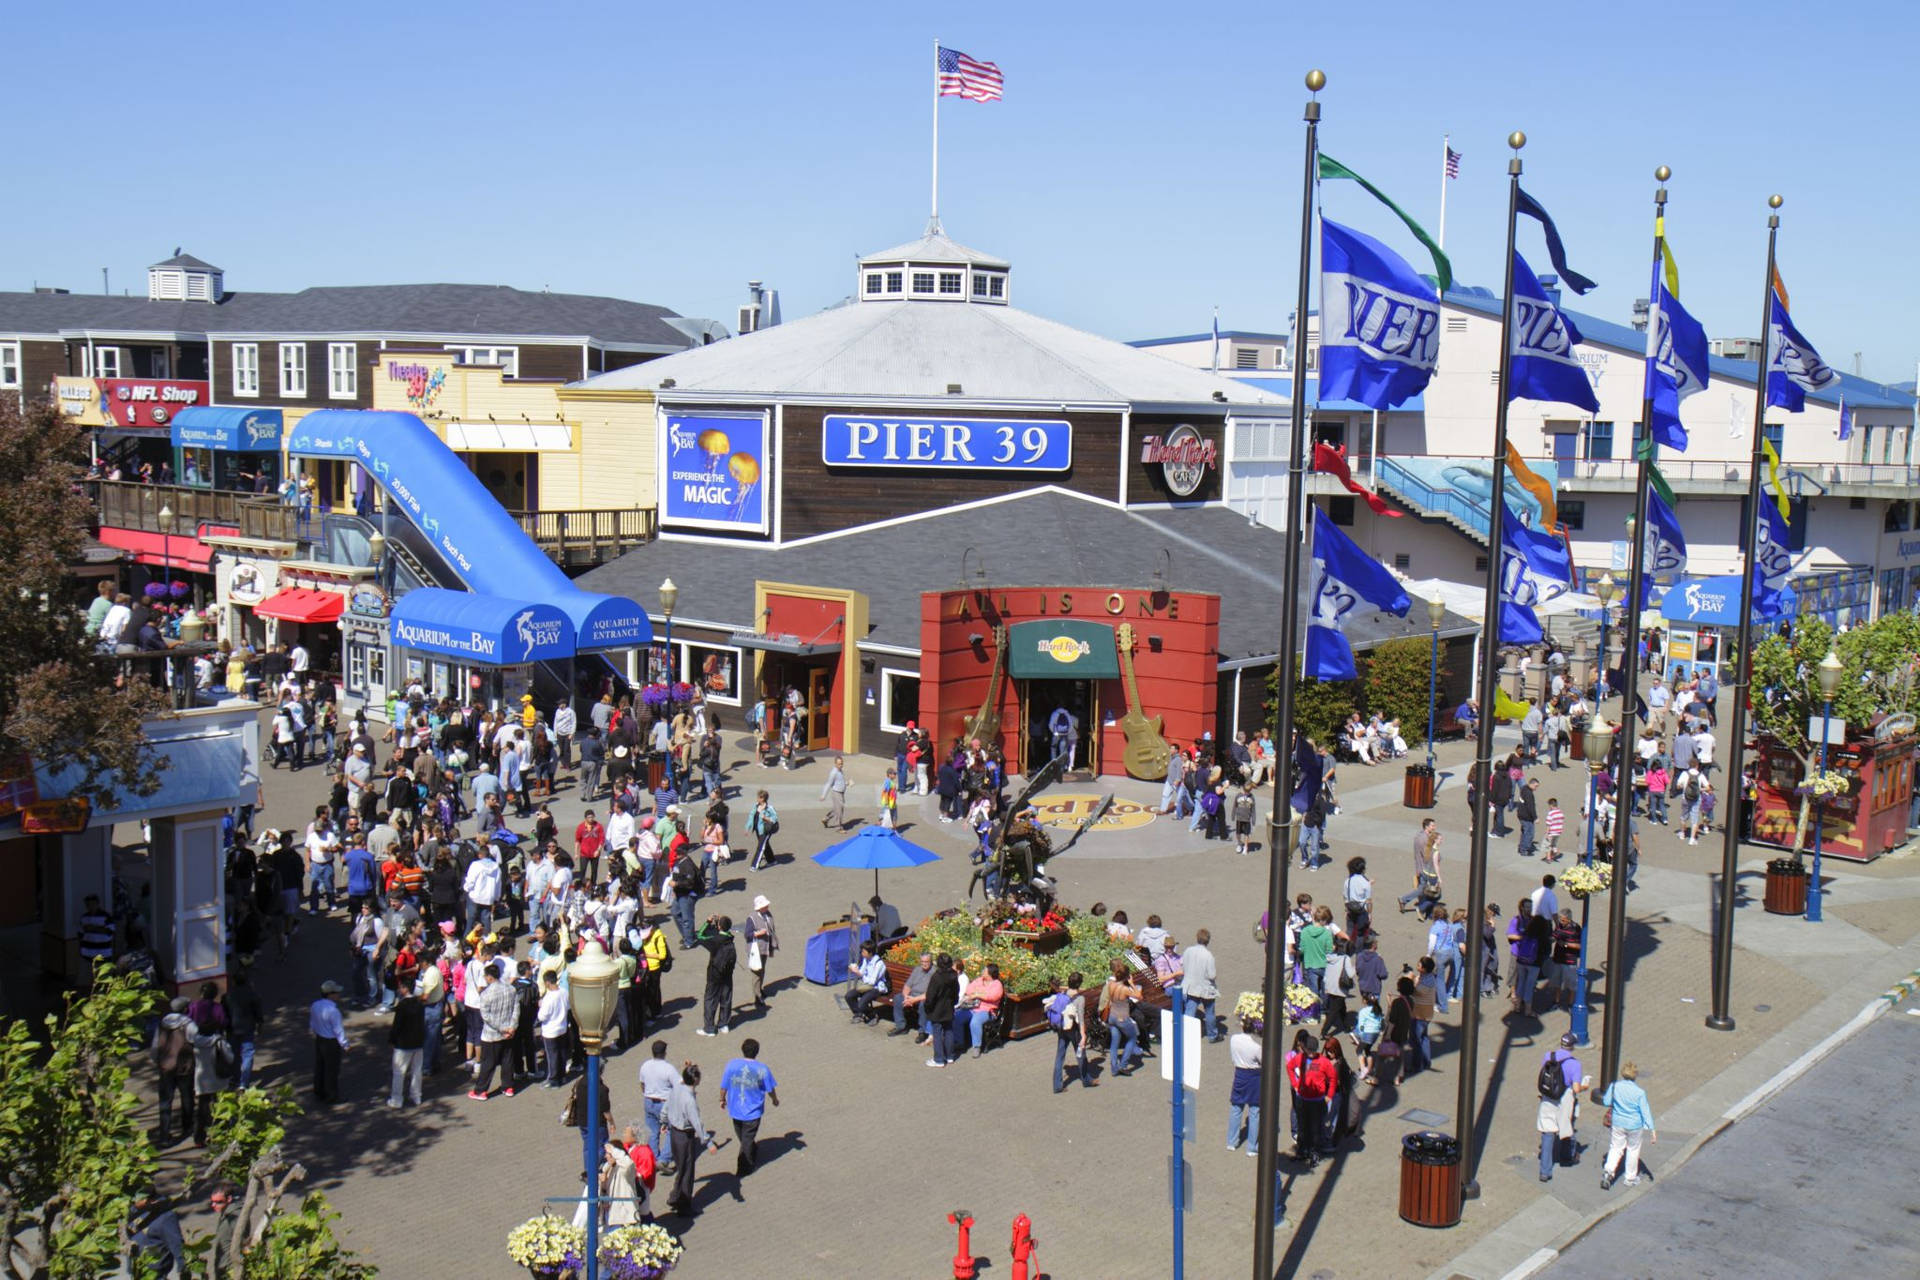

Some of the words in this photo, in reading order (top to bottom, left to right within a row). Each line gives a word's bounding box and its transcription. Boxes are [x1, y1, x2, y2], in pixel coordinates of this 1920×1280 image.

[1344, 281, 1439, 362] PIER
[1517, 302, 1571, 358] PIE
[1577, 352, 1608, 365] RIUM
[388, 361, 428, 382] Theatre
[131, 386, 158, 400] NFL
[161, 386, 197, 404] Shop
[259, 430, 276, 438] BAY
[681, 438, 696, 449] BAY
[845, 422, 976, 462] PIER
[992, 426, 1048, 464] 39
[673, 470, 711, 482] EXPERIENCE
[712, 473, 725, 484] THE
[684, 484, 732, 505] MAGIC
[408, 496, 421, 513] Fish
[442, 535, 458, 557] Touch
[457, 553, 472, 571] Pool
[957, 594, 1010, 616] ALL
[1040, 593, 1073, 614] IS
[1105, 592, 1179, 618] ONE
[1701, 601, 1725, 613] BAY
[526, 620, 562, 631] AQUARIUM
[592, 617, 640, 630] AQUARIUM
[396, 619, 451, 647] AQUARIUM
[450, 639, 459, 648] OF
[472, 631, 496, 655] BAY
[536, 631, 561, 646] BAY
[593, 628, 639, 641] ENTRANCE
